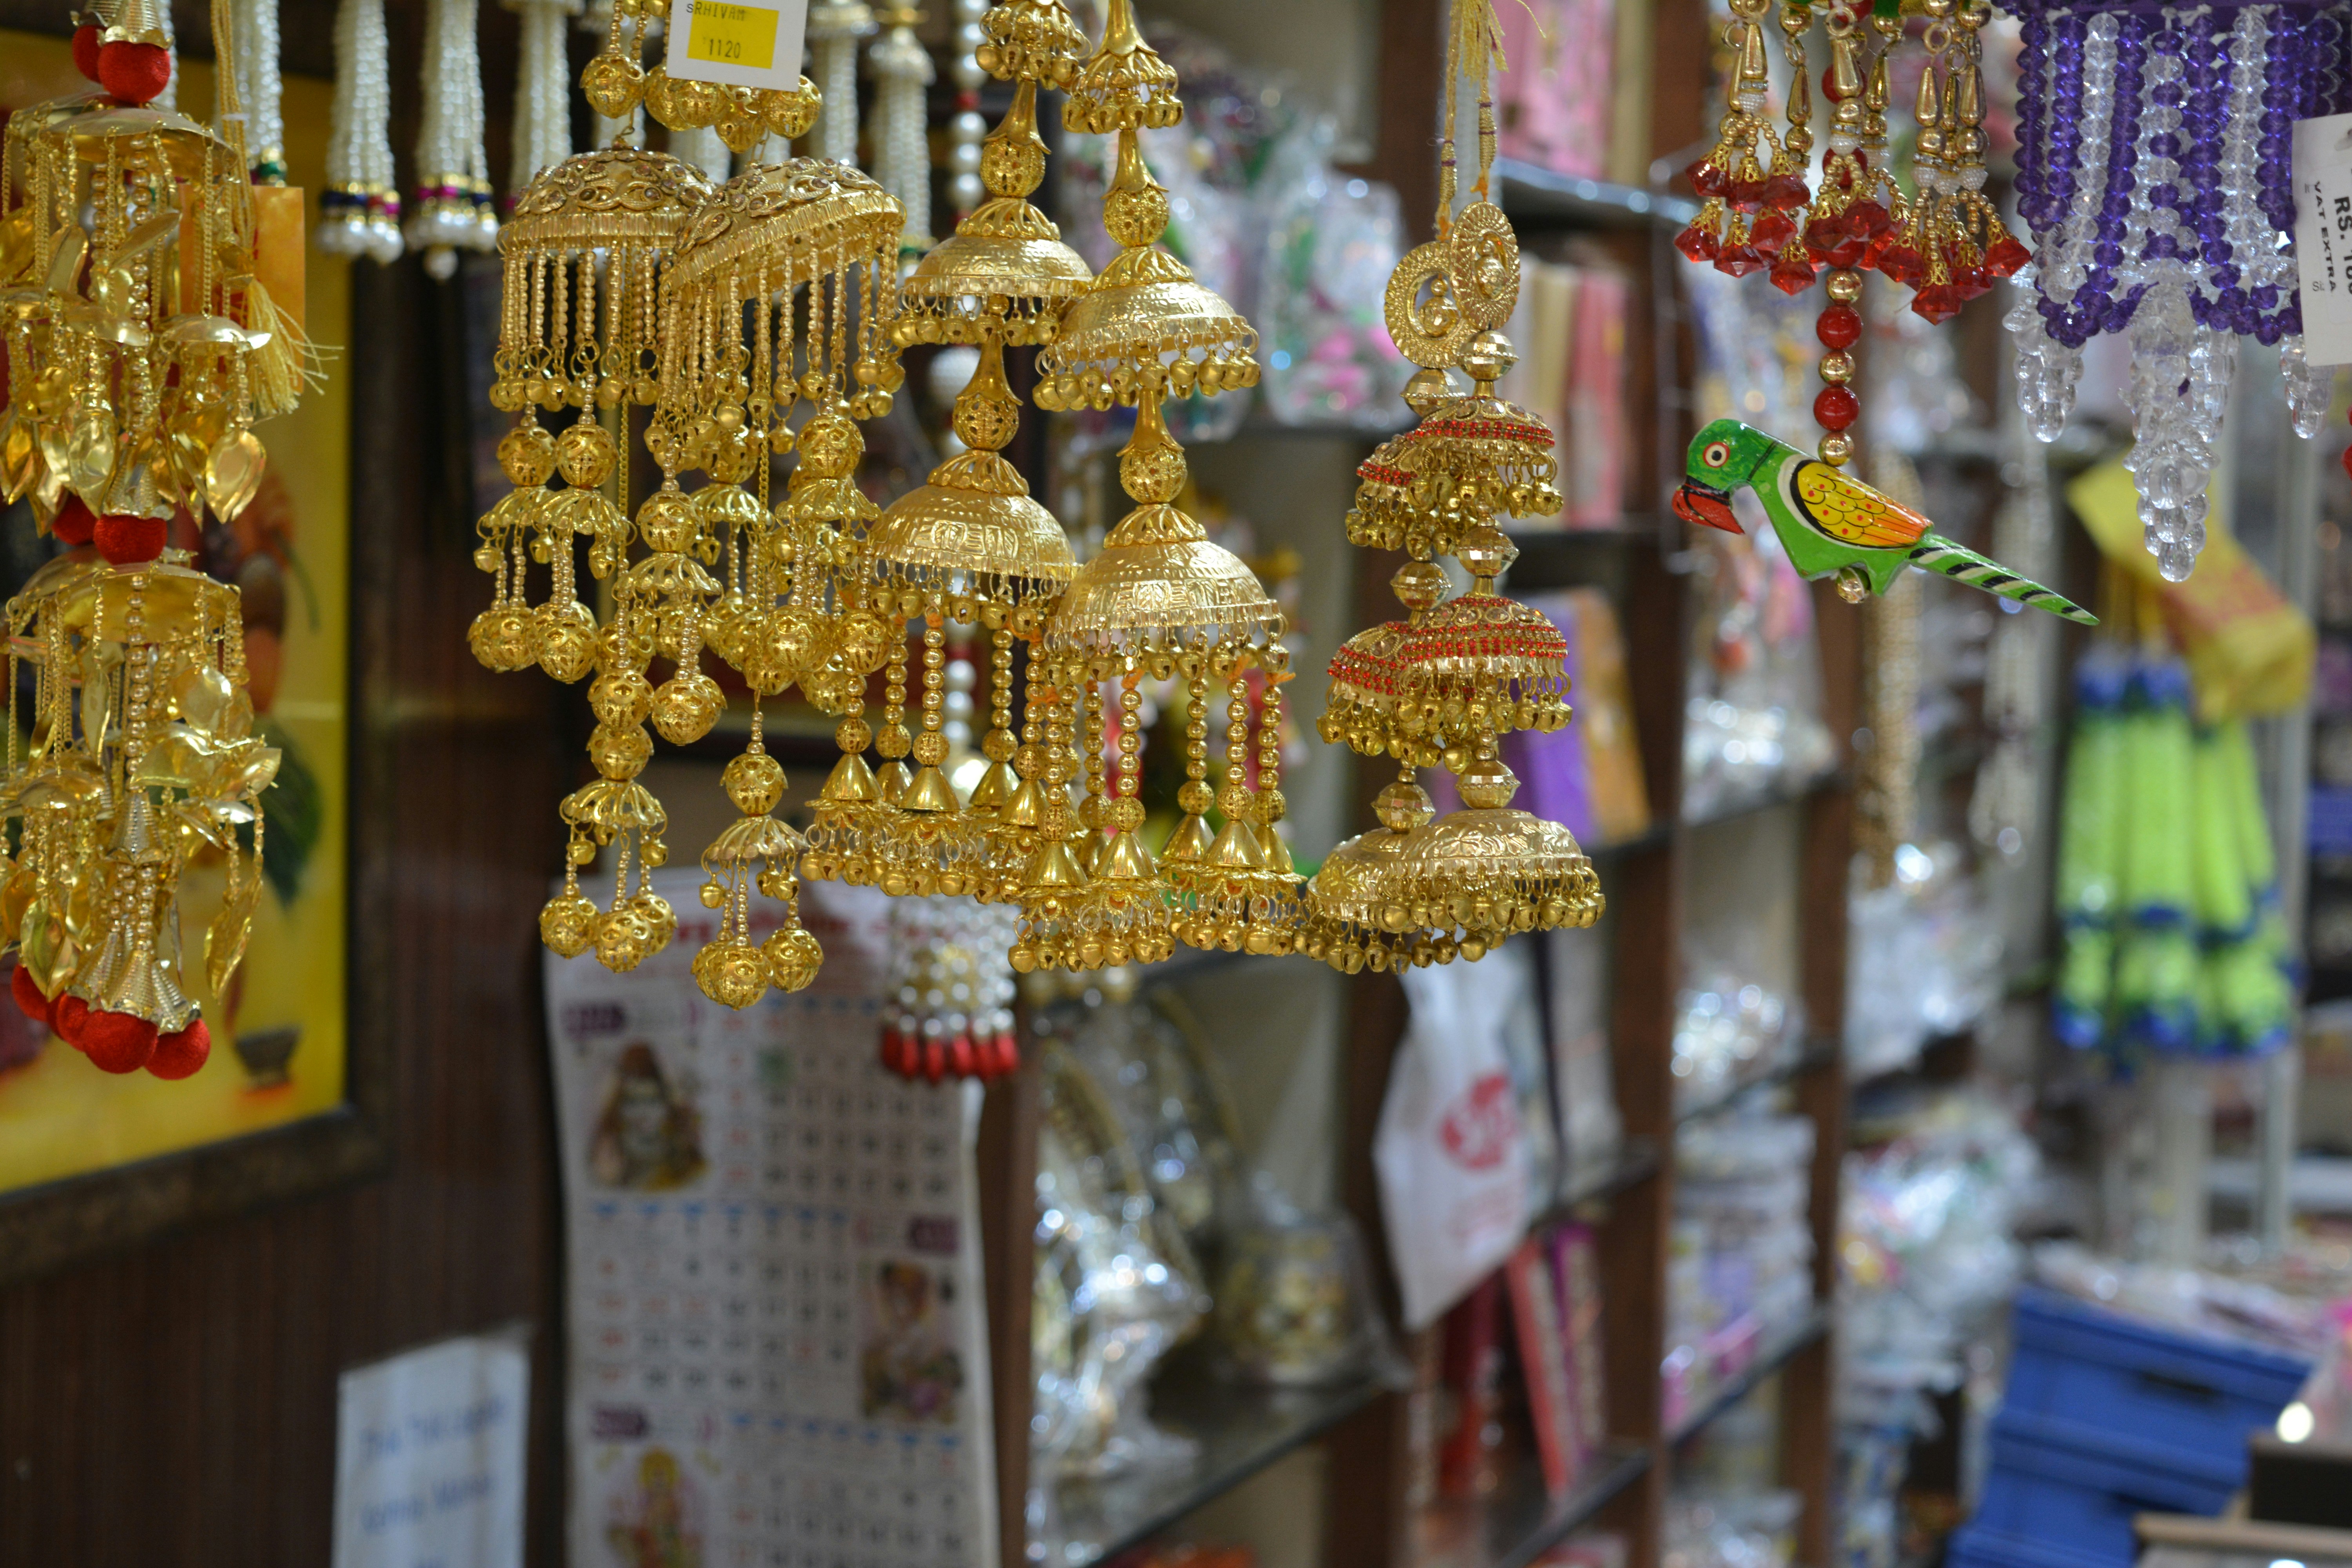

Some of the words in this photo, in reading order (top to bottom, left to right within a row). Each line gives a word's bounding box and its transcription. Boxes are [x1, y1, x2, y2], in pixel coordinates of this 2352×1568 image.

[709, 38, 741, 58] 1120
[2314, 180, 2326, 220] VAT
[2321, 227, 2336, 293] EXTRA
